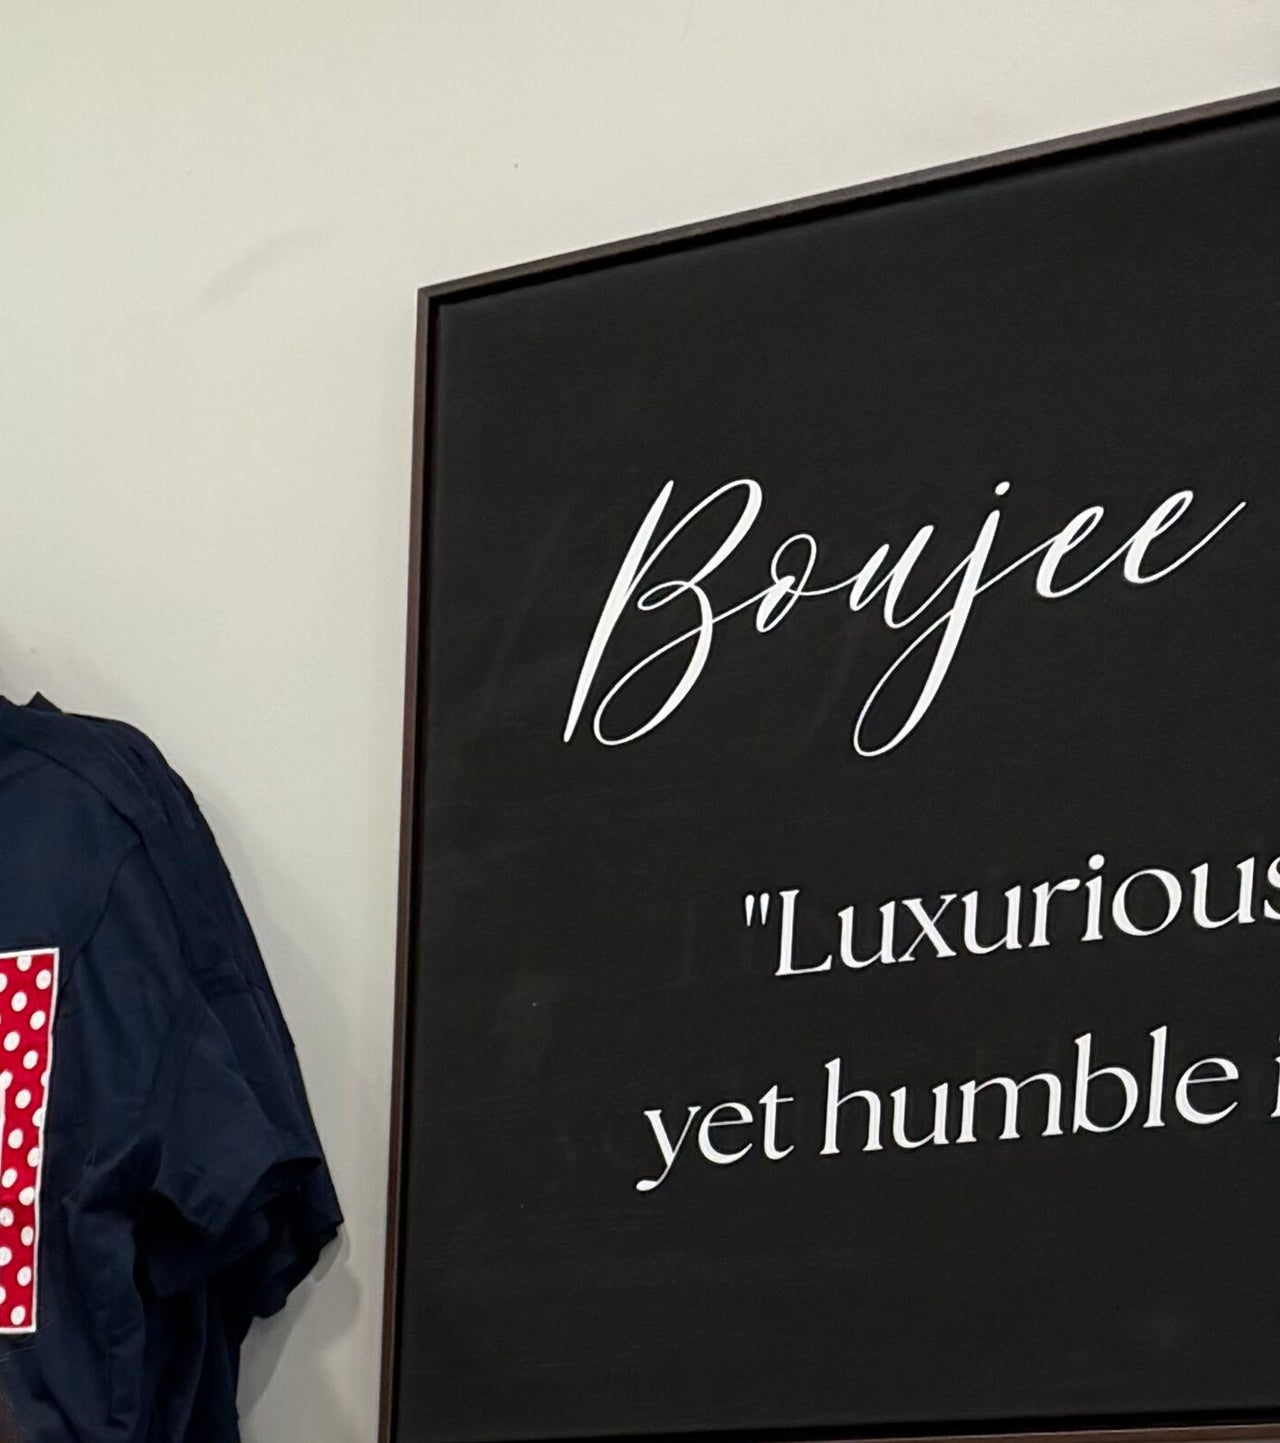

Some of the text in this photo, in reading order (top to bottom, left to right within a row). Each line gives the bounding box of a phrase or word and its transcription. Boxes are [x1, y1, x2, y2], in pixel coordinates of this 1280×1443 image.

[563, 479, 1247, 757] Boujee
[636, 1085, 795, 1192] yet
[820, 1026, 1240, 1155] humble
